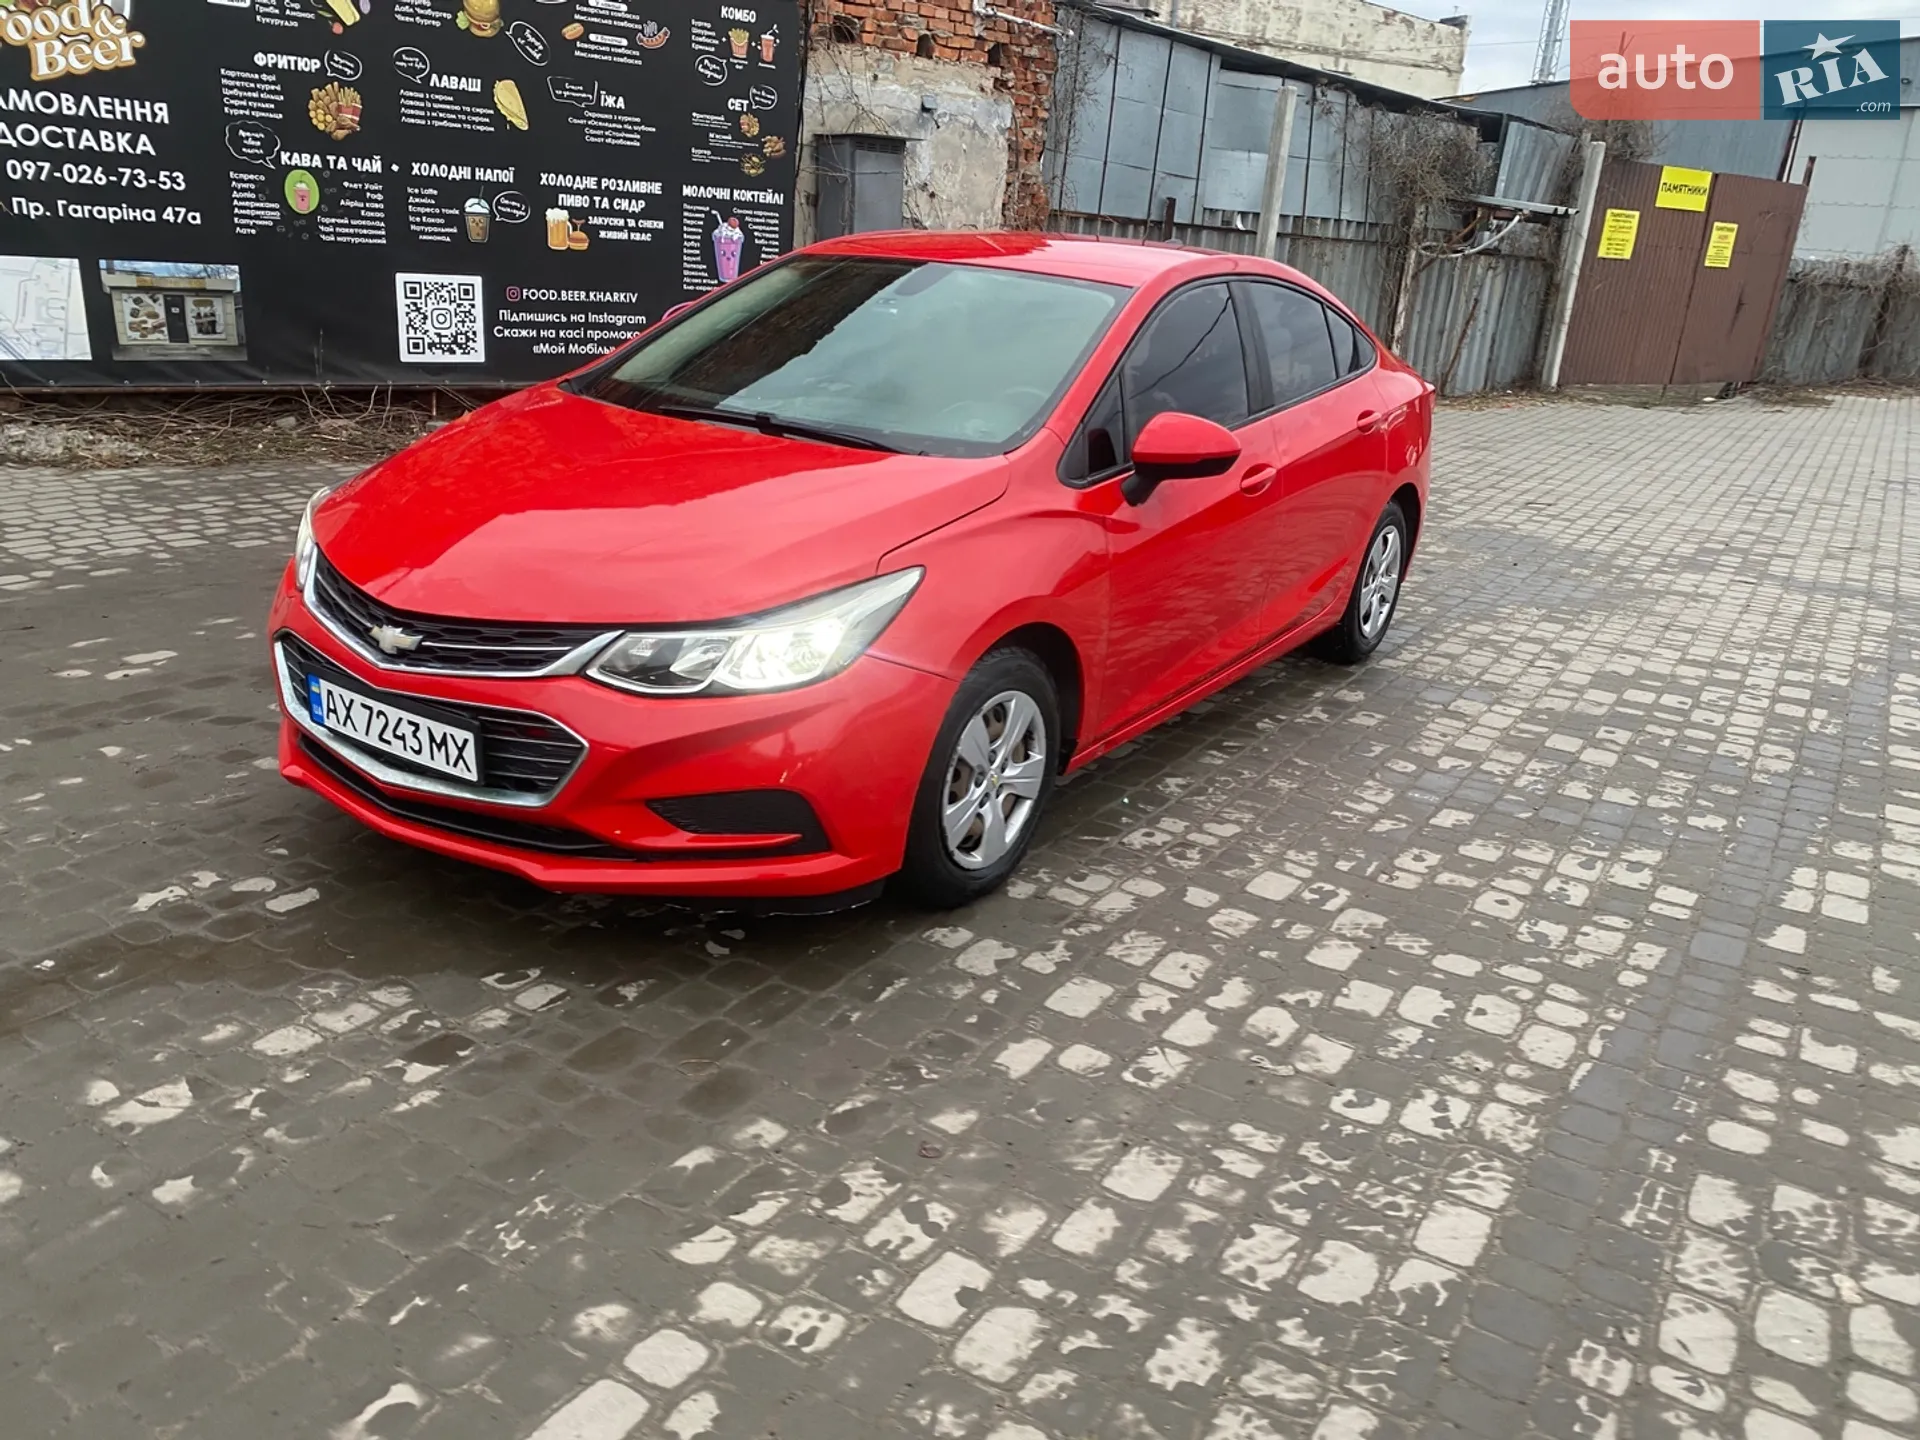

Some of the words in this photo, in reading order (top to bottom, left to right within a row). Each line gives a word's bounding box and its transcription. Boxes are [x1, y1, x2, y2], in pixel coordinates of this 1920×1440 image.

[0, 2, 92, 41] ood
[94, 7, 126, 38] &
[720, 5, 757, 23] КОМБО
[34, 33, 145, 76] Beer
[253, 51, 322, 73] ФРИТЮР
[429, 73, 482, 93] ЛАВАШ
[600, 90, 625, 110] ЇЖА
[727, 97, 750, 112] СЕТ
[0, 122, 156, 156] ДОСТАВКА
[280, 150, 322, 168] КАВА
[326, 155, 348, 170] ТА
[351, 154, 382, 174] ЧАЙ
[411, 161, 472, 181] ХОЛОДНІ
[474, 166, 515, 183] НАПОЇ
[6, 159, 186, 191] 097-026-73-53
[229, 171, 266, 182] Еспресо
[540, 172, 598, 191] ХОЛОДНЕ
[601, 178, 663, 195] РОЗЛИВНЕ
[682, 184, 731, 200] МОЛОЧНІ
[733, 188, 784, 205] КОКТЕЙЛІ
[1660, 182, 1708, 196] ПАМЯТНИКИ
[11, 196, 51, 219] Пр.
[57, 199, 156, 224] Гагаріна
[162, 206, 202, 225] 47а
[232, 199, 280, 209] Американо
[558, 193, 590, 209] ПИВО
[593, 197, 610, 210] ТА
[613, 197, 646, 213] СИДР
[587, 215, 625, 227] ЗАКУСКИ
[626, 218, 636, 228] ТА
[638, 219, 664, 230] СНЕКИ
[598, 228, 628, 241] ЖИВИЙ
[630, 231, 652, 242] КВАС
[522, 288, 638, 304] FOOD.BEER.KHARKIV
[498, 309, 567, 323] Підпишись
[570, 312, 585, 323] на
[588, 312, 647, 326] Instagram
[493, 326, 537, 338] Скажи
[540, 328, 555, 338] на
[559, 327, 584, 338] касі
[326, 689, 358, 732] AX
[360, 703, 423, 756] 7243
[427, 726, 472, 774] MX
